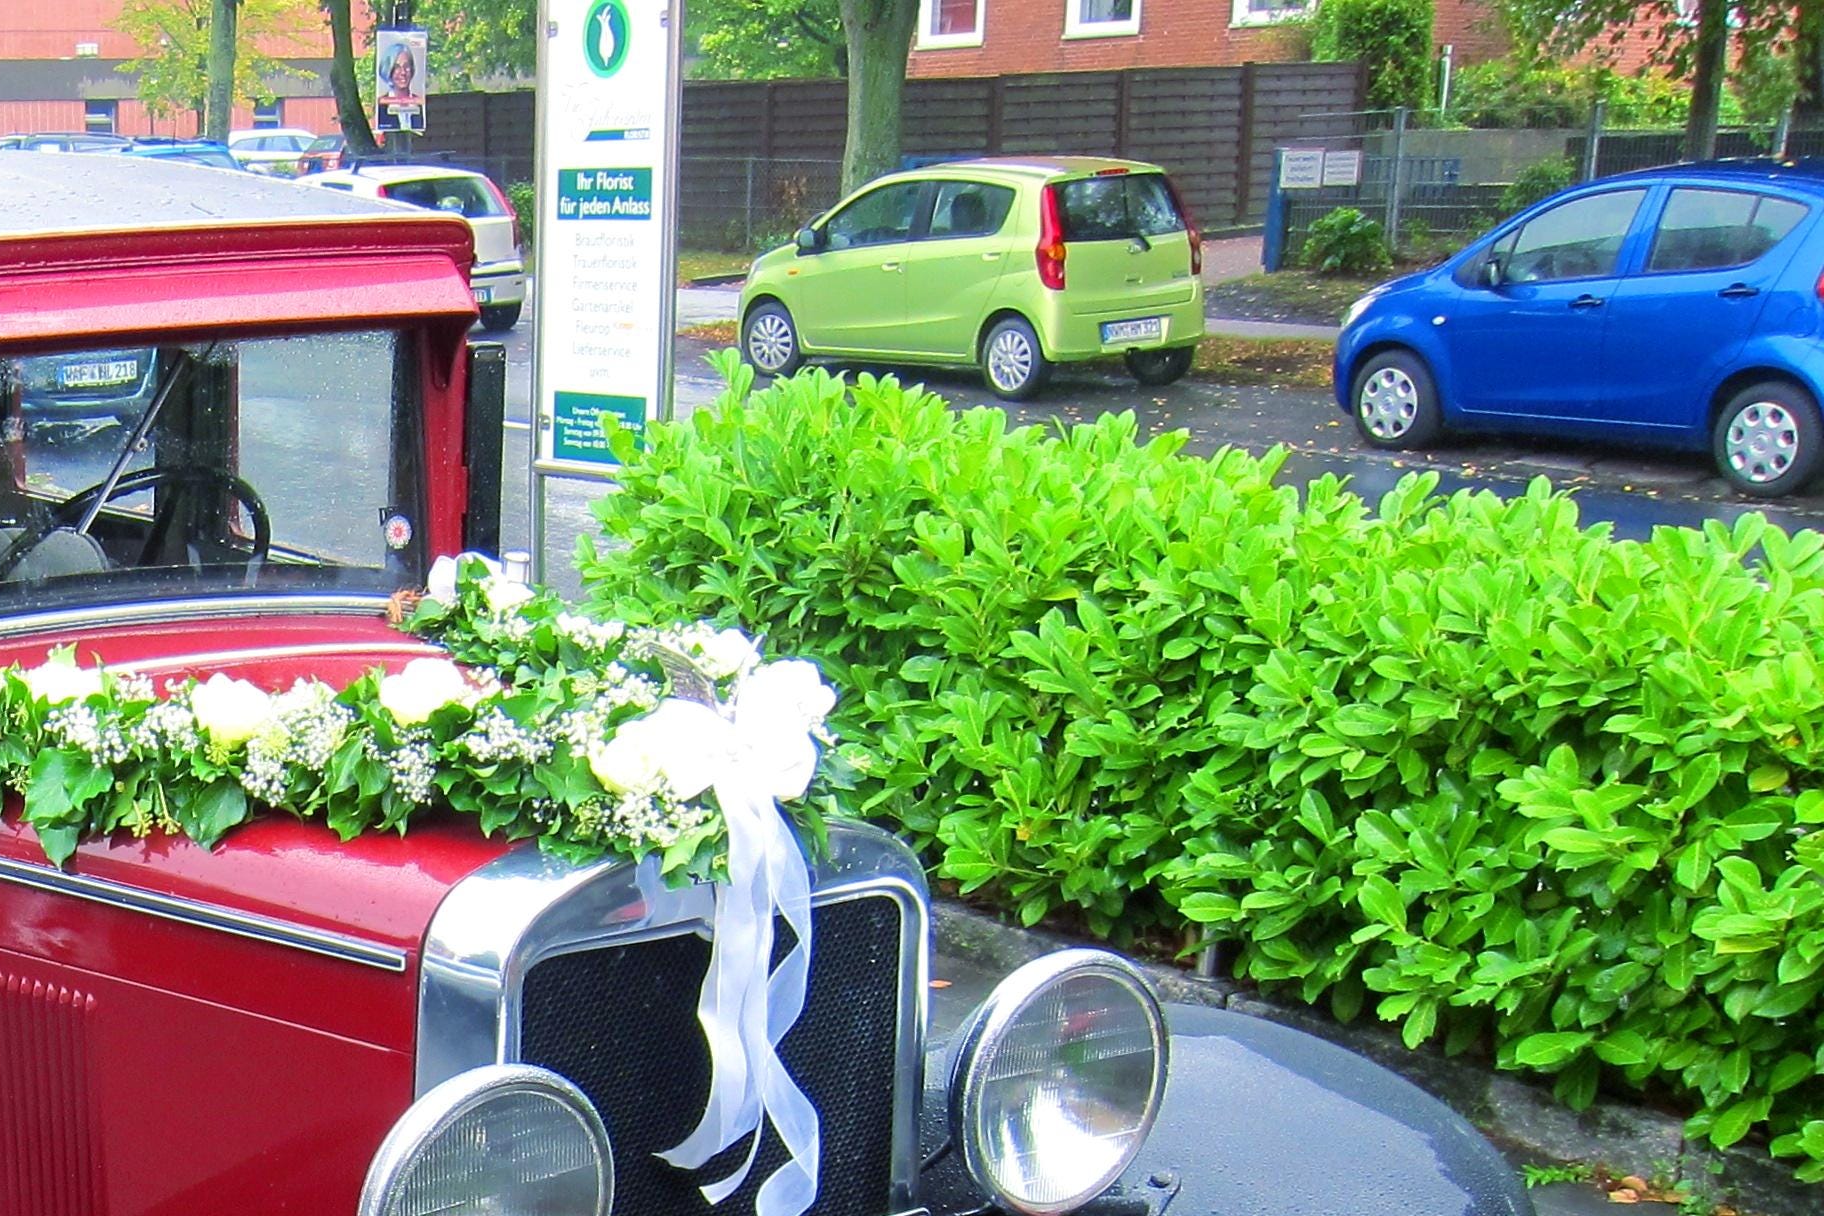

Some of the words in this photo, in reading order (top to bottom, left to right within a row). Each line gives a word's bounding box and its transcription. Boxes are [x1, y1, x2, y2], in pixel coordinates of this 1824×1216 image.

[576, 172, 594, 190] Ihr
[596, 171, 634, 190] Florist
[560, 196, 577, 215] für
[579, 196, 611, 220] jeden
[612, 196, 650, 215] Anlass
[114, 362, 136, 378] 218
